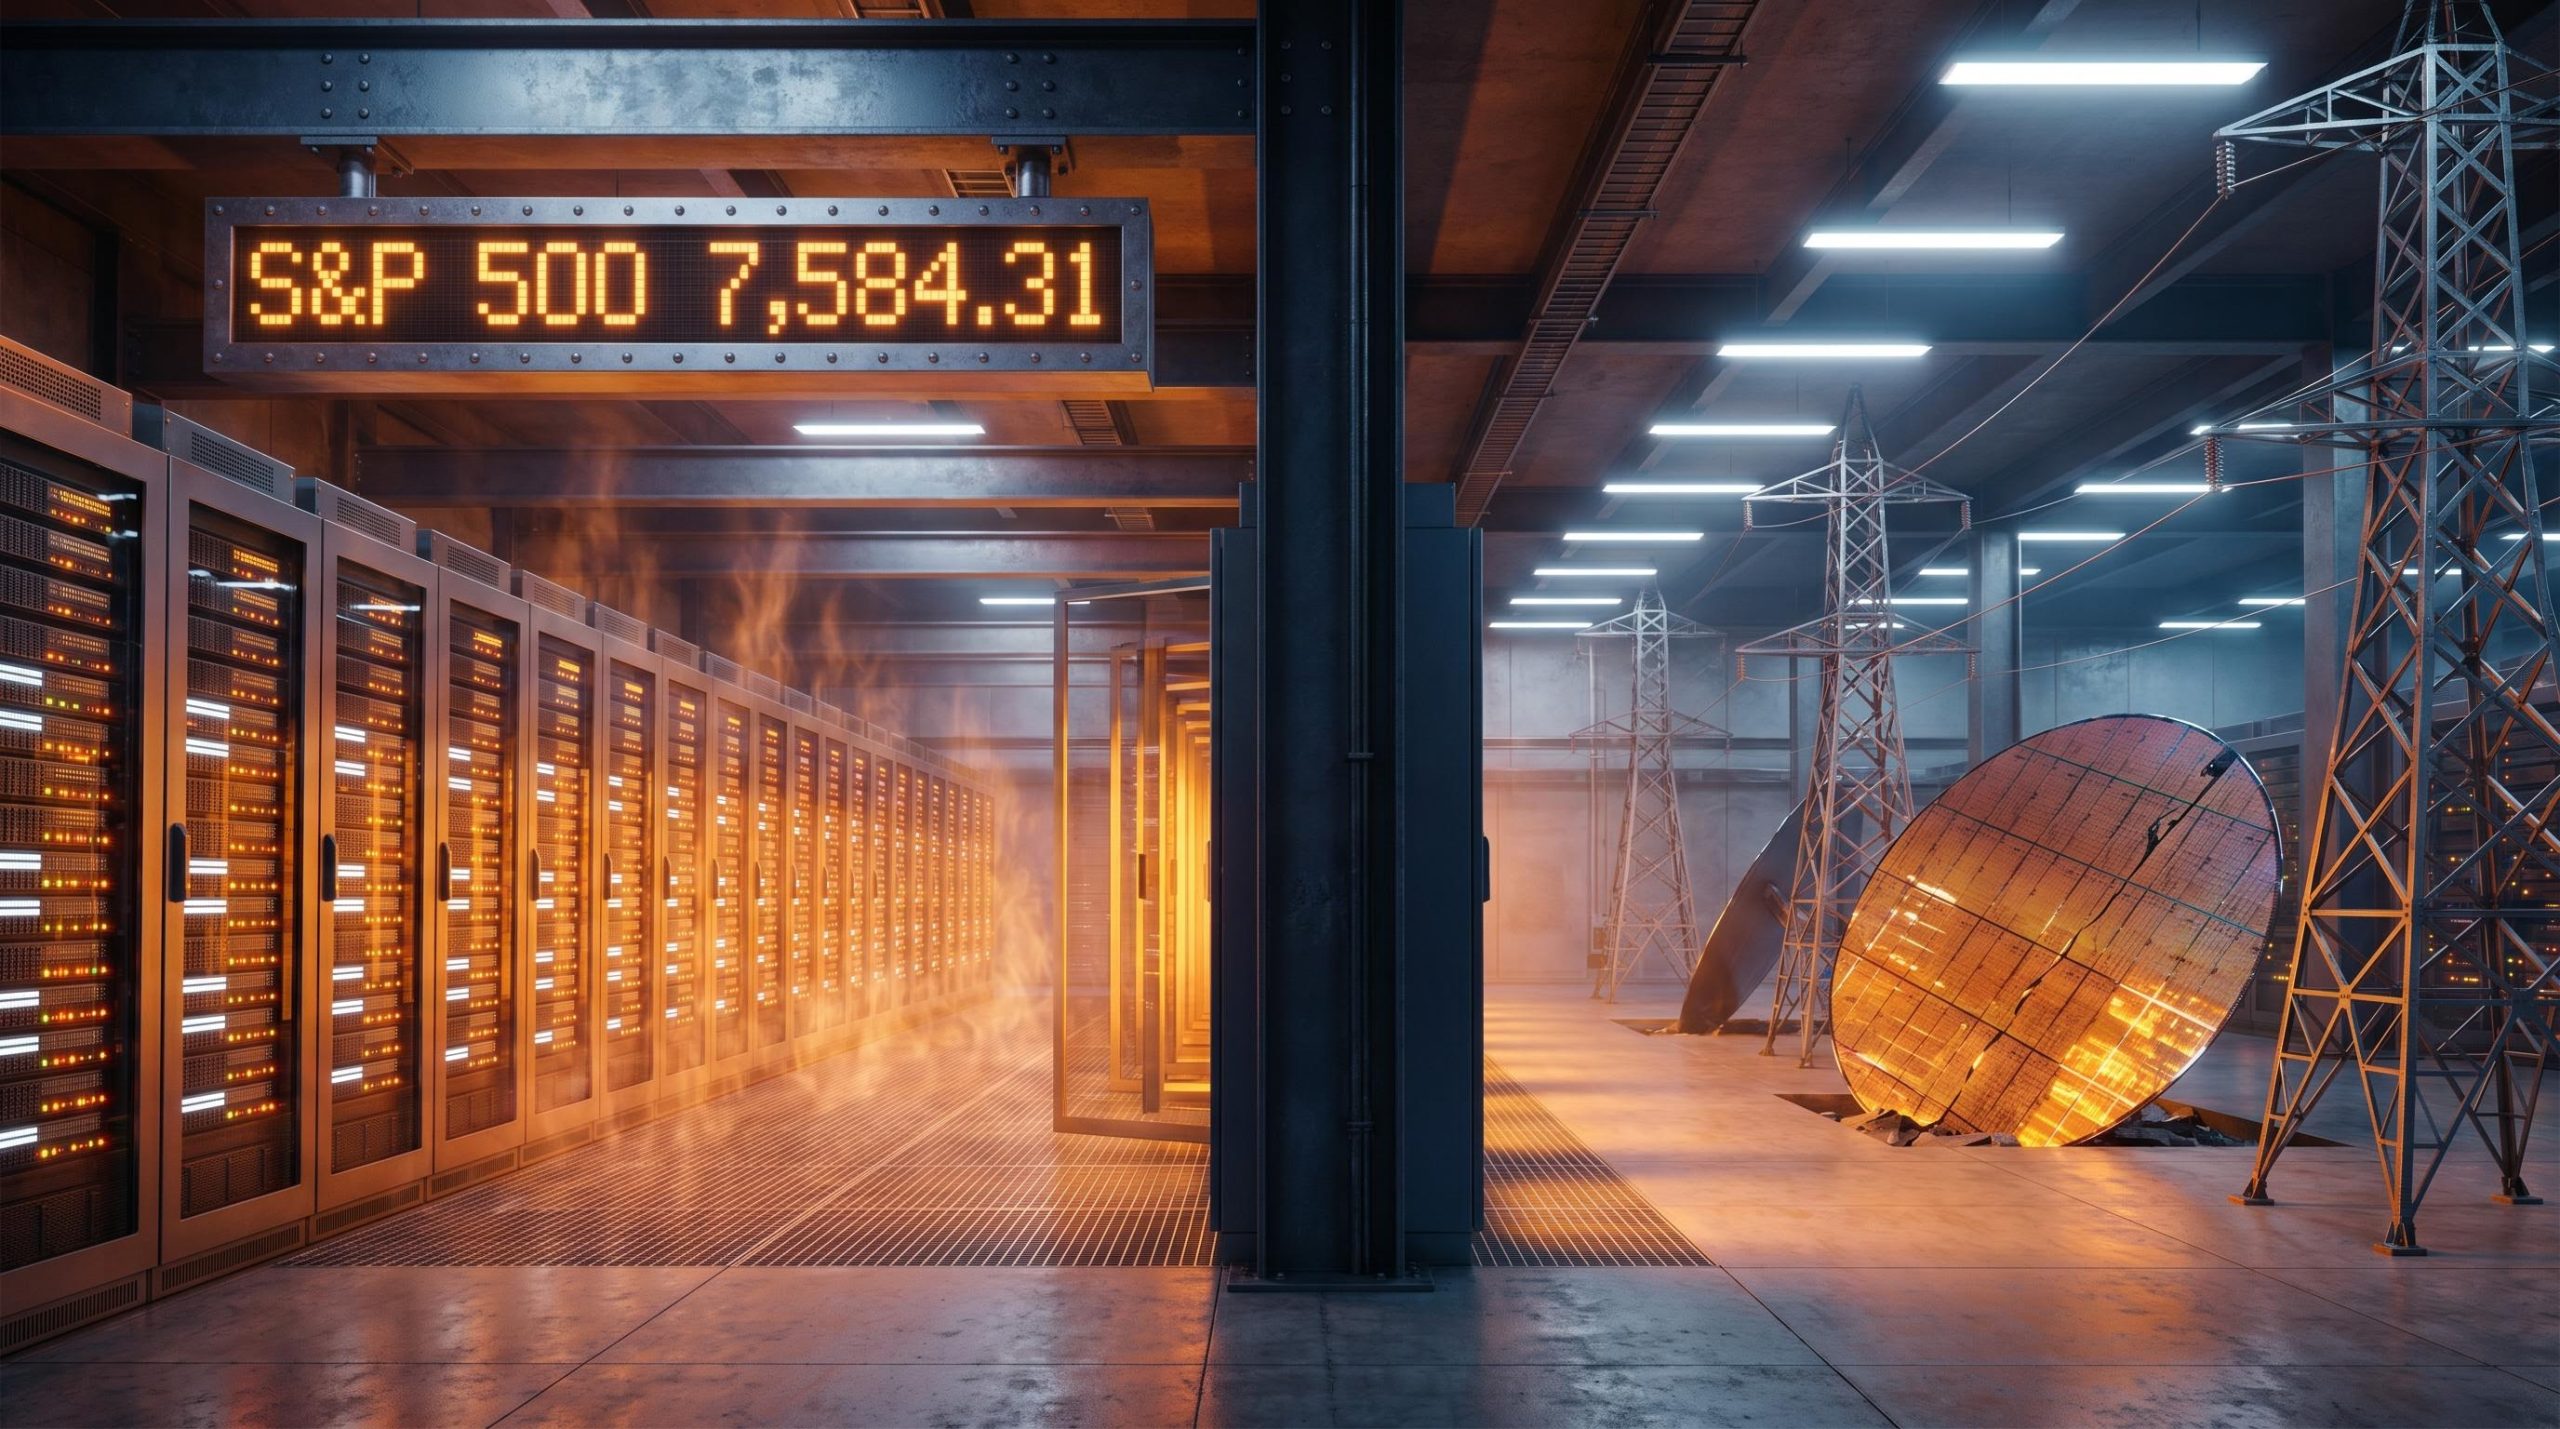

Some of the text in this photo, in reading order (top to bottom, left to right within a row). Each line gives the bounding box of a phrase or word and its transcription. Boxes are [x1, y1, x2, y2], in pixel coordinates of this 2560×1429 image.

[248, 240, 1103, 336] S&P 500 7,584.31
